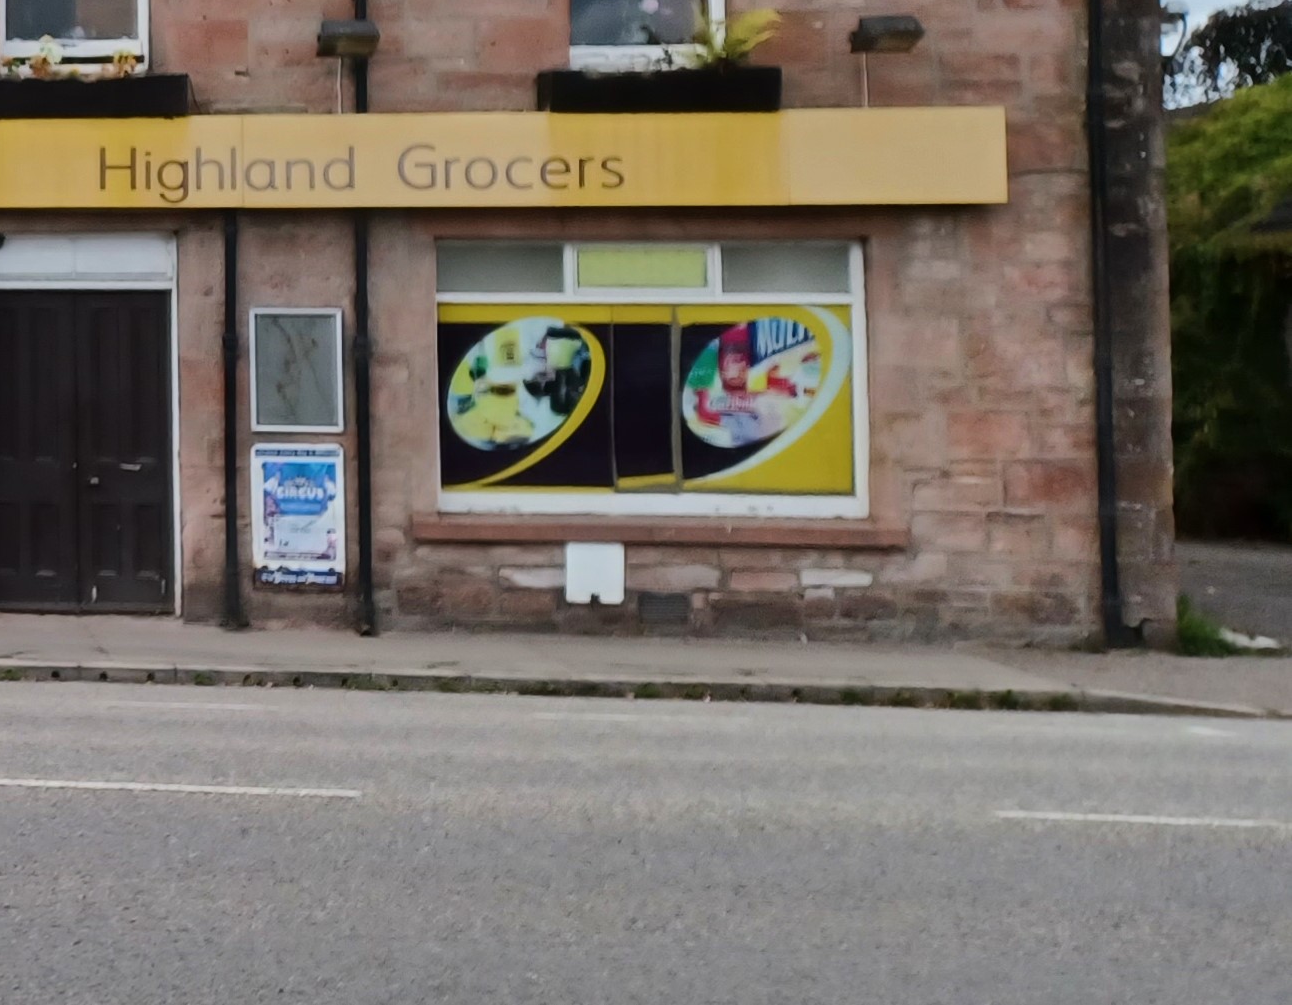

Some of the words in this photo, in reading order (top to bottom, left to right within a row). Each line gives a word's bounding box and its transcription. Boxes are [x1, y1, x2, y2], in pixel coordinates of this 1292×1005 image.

[99, 145, 356, 204] Highland
[396, 143, 626, 191] Grocers
[276, 484, 325, 501] CIRCUS
